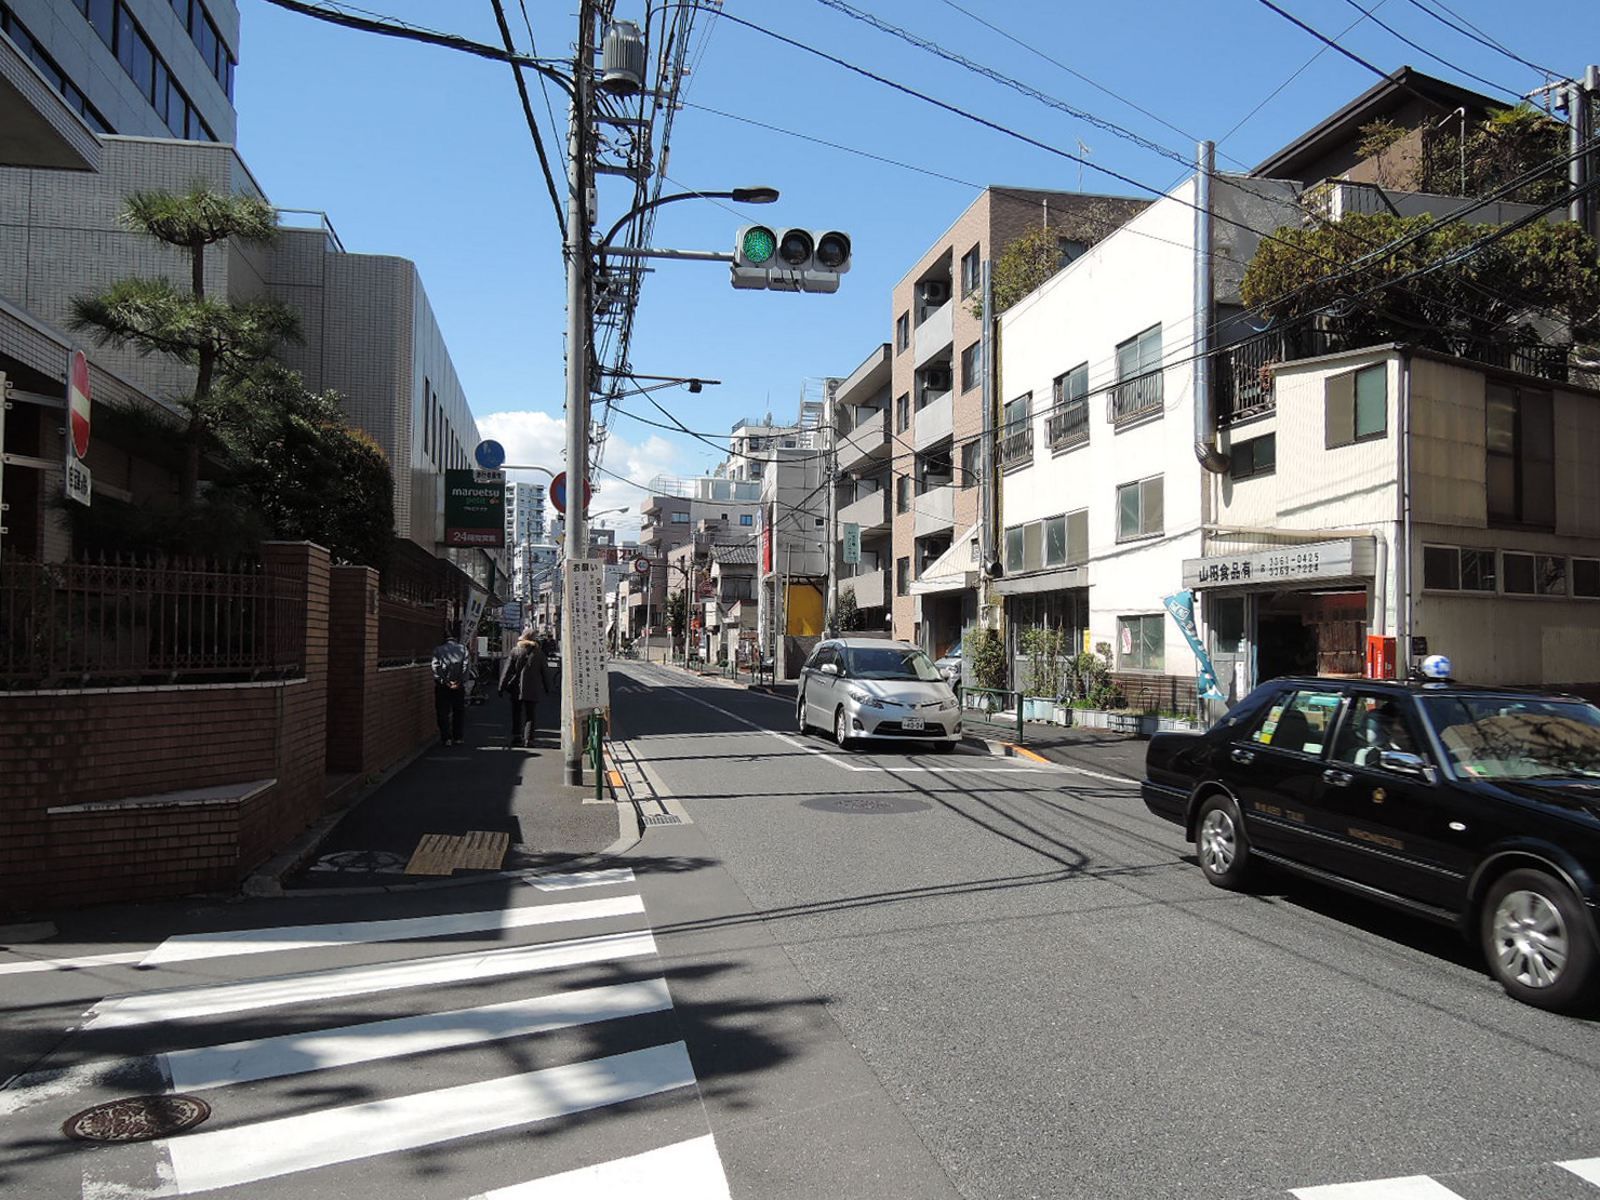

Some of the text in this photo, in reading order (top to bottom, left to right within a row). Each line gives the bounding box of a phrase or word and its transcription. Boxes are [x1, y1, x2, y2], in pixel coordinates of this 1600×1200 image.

[452, 488, 500, 497] maruetsu
[573, 562, 599, 572] お願い
